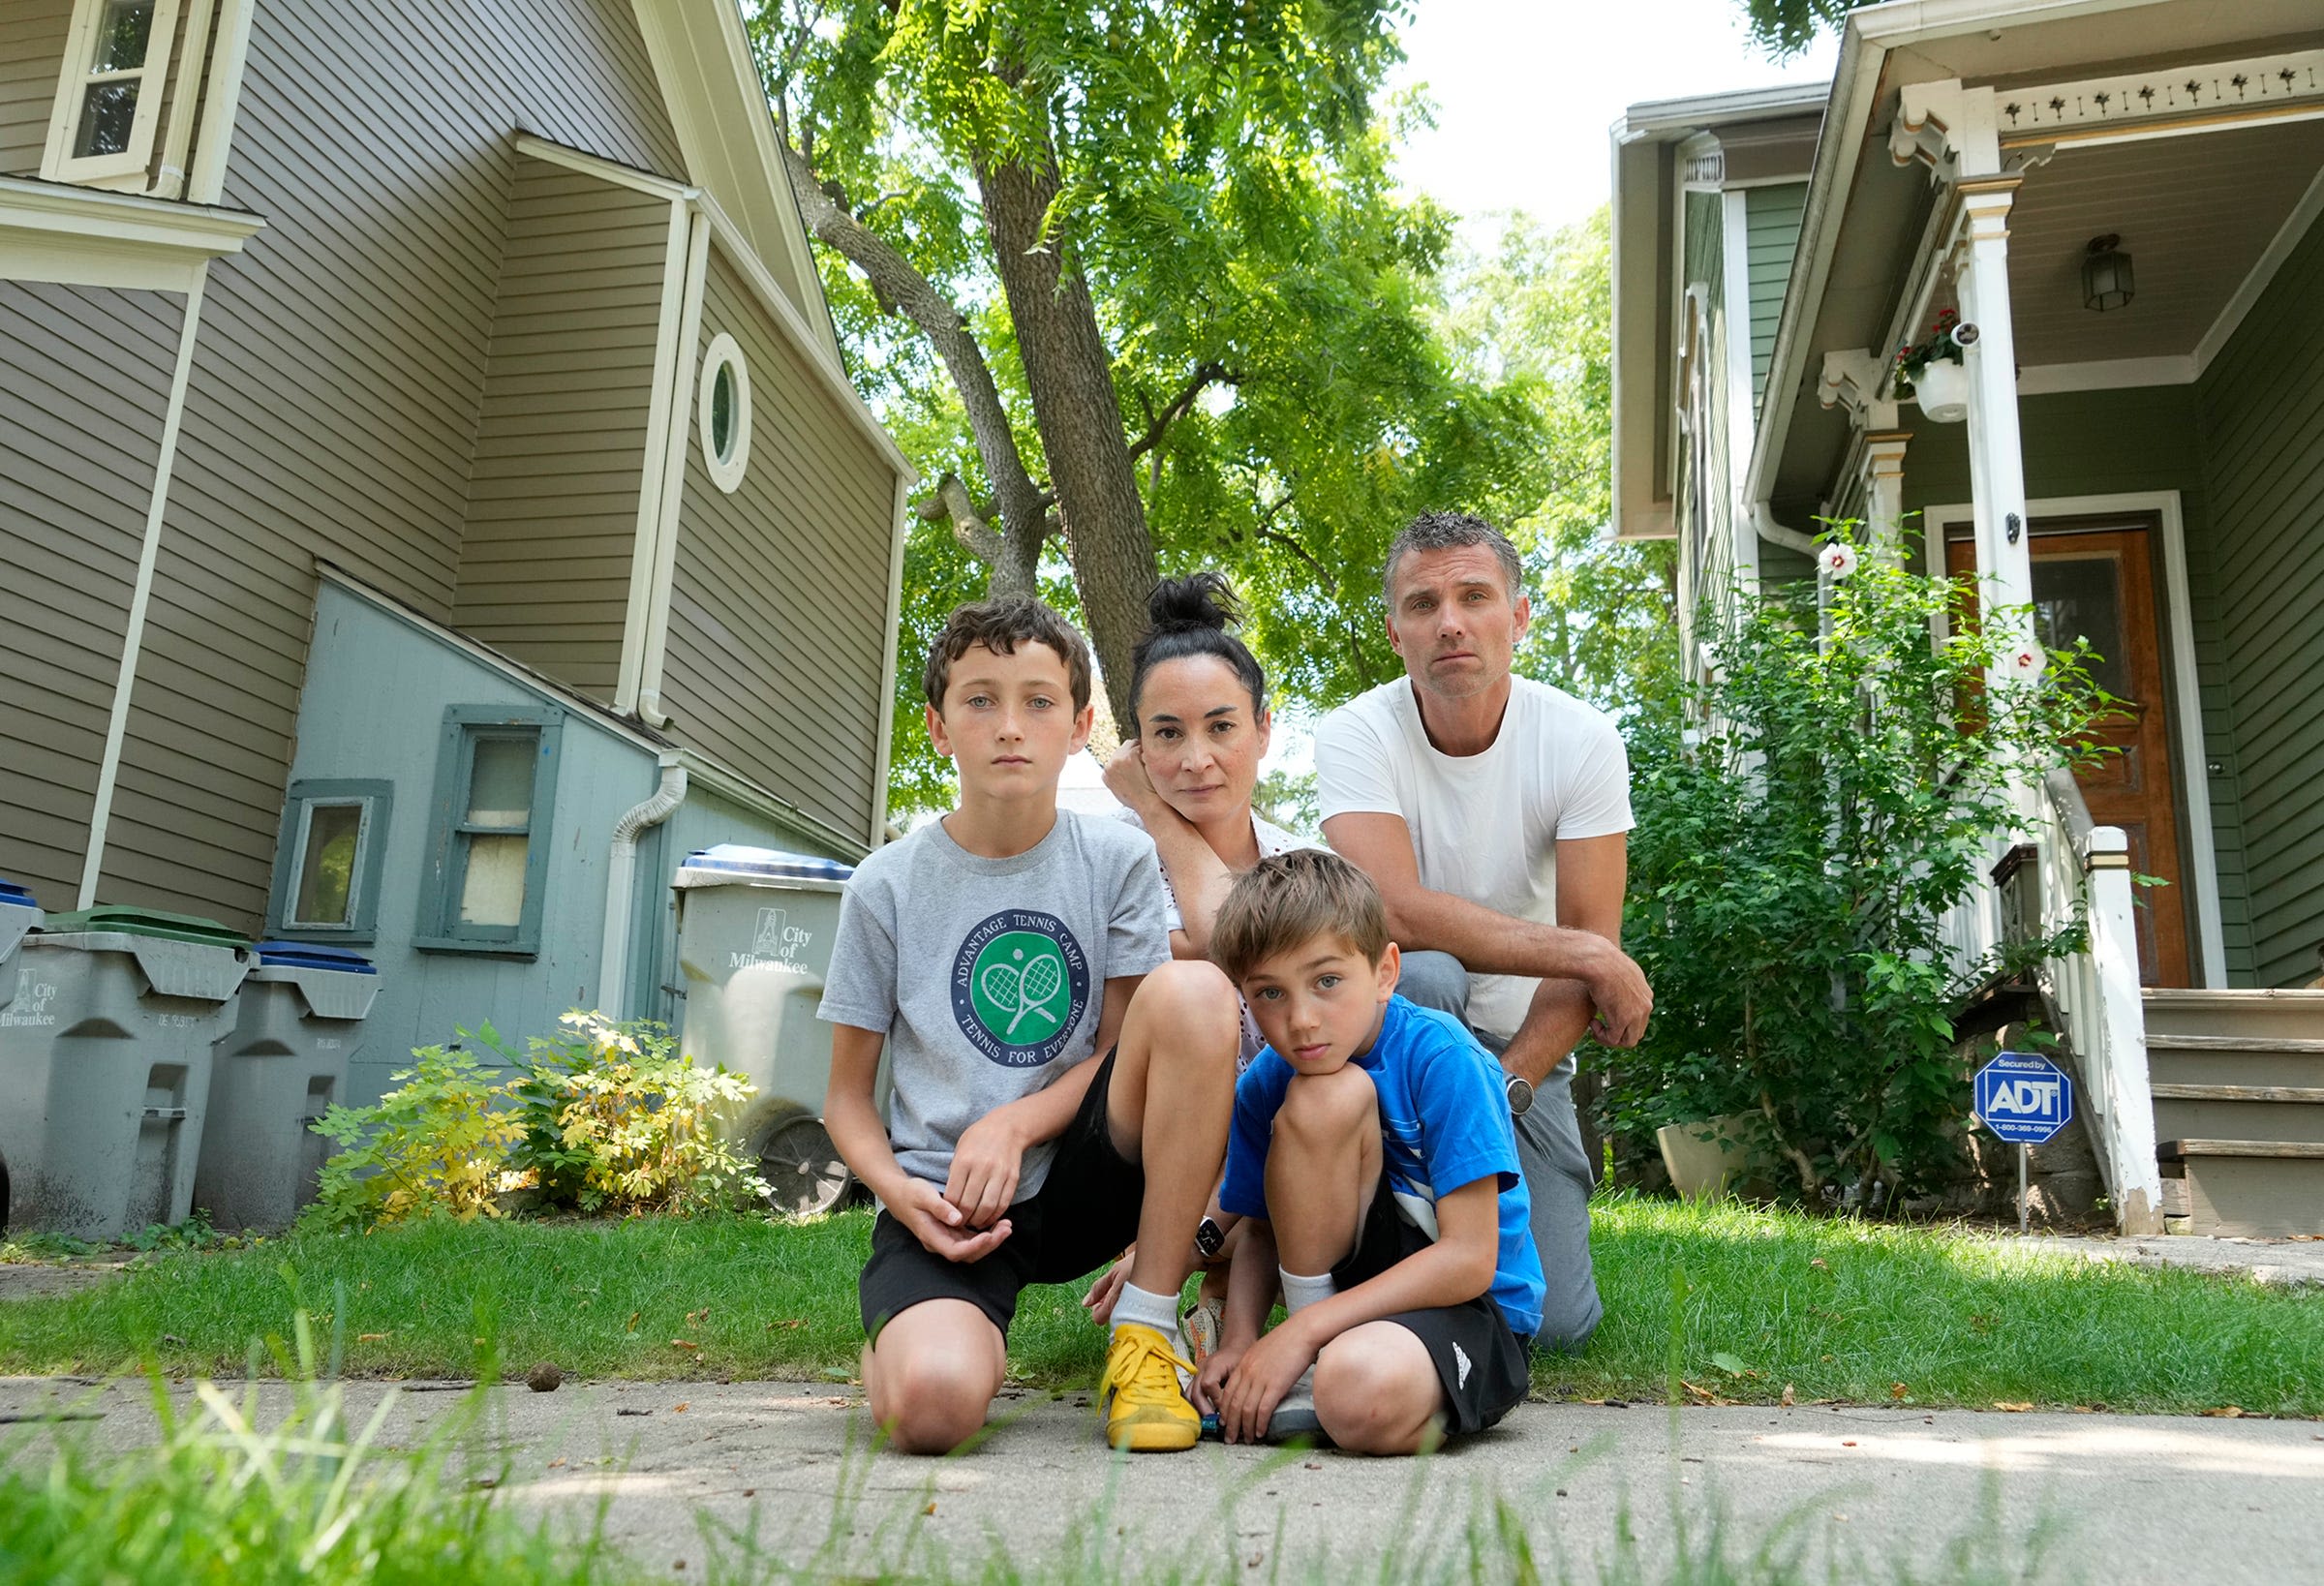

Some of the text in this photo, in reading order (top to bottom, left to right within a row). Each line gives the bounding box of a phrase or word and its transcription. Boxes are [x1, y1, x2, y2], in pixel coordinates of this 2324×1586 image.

[782, 926, 812, 947] City
[780, 943, 798, 959] of
[957, 914, 1083, 987] ADVANTAGE TENNIS CAMP
[729, 952, 809, 975] Milwaukee
[35, 983, 57, 1000] City
[32, 998, 46, 1012] of
[962, 999, 1084, 1063] TENNIS FOR EVERYONE
[1998, 1059, 2046, 1071] Secured by
[1988, 1080, 2059, 1115] ADT
